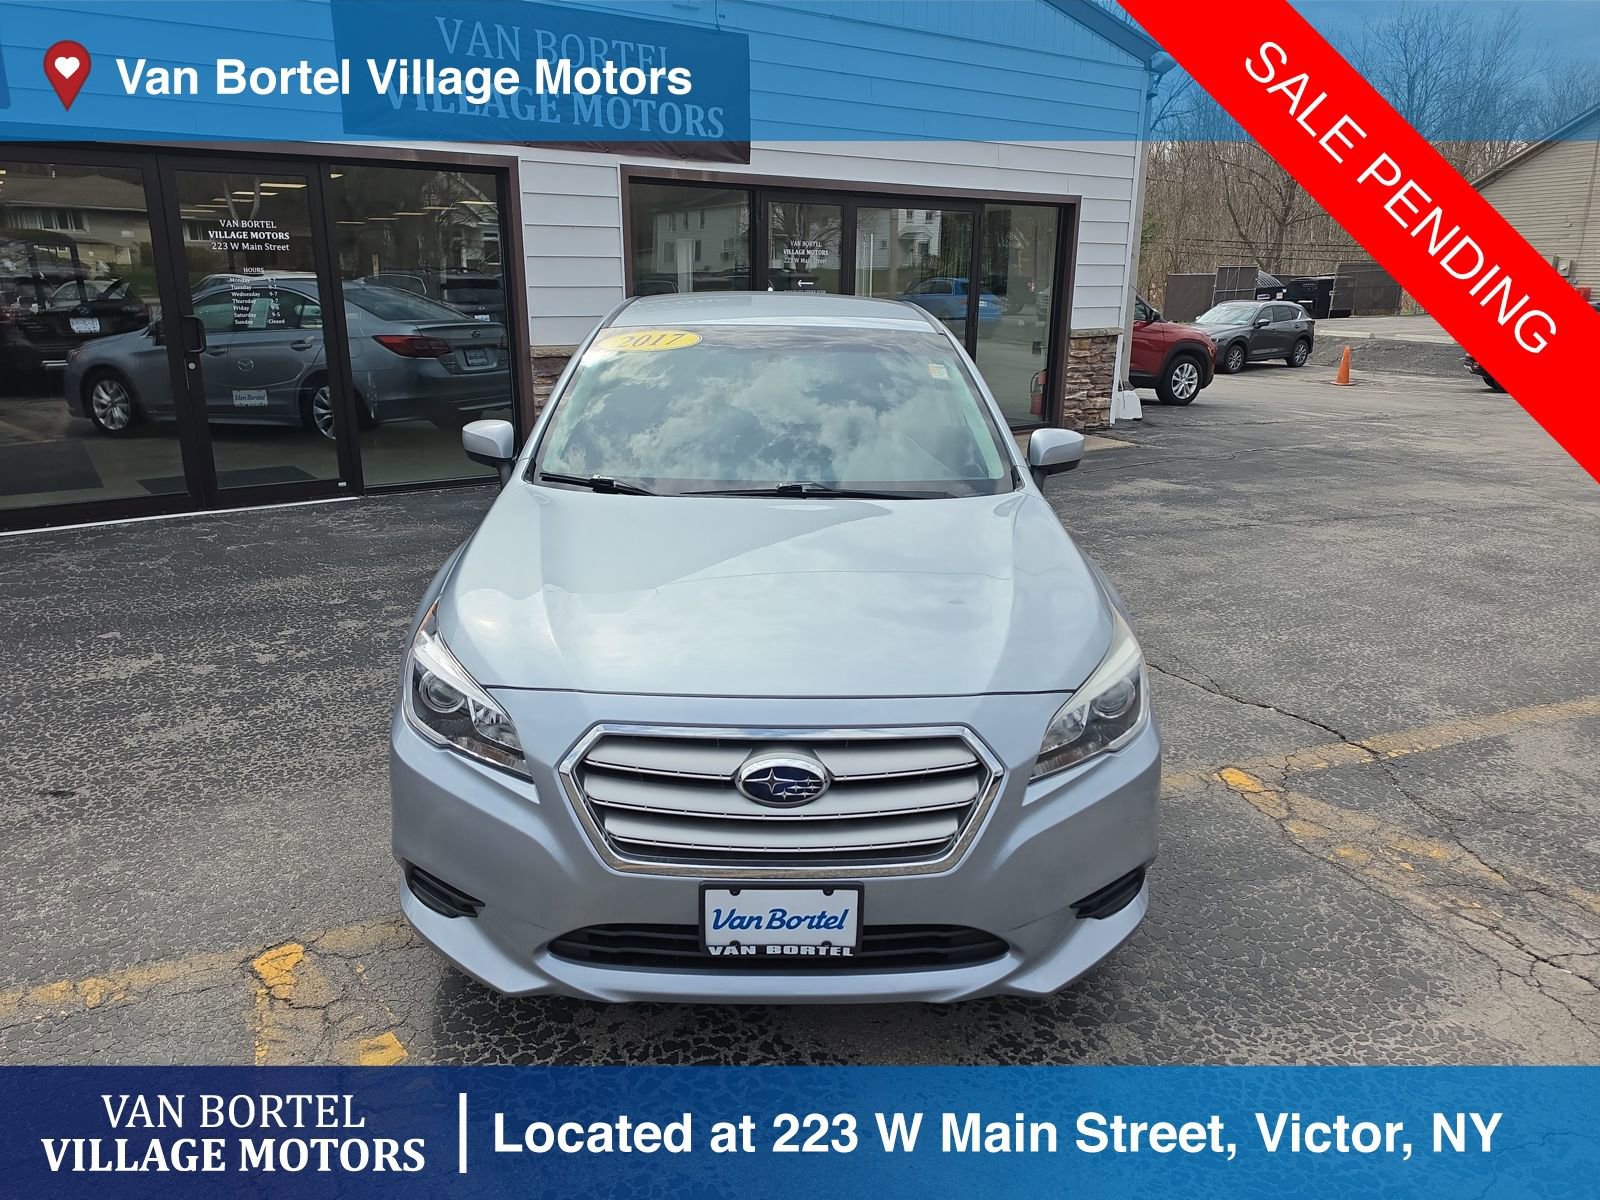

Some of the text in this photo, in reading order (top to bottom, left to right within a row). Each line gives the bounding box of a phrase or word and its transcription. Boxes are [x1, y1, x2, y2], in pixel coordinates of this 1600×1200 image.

[434, 16, 520, 62] VAN
[572, 92, 725, 138] MOTORS
[219, 219, 277, 229] VAN BORTEL
[208, 230, 290, 240] VILLAGE MOTORS
[211, 241, 290, 251] 223 W Main Street
[621, 333, 687, 349] 2017
[712, 908, 850, 930] Van Bortel
[708, 945, 854, 957] VAN BORTEL
